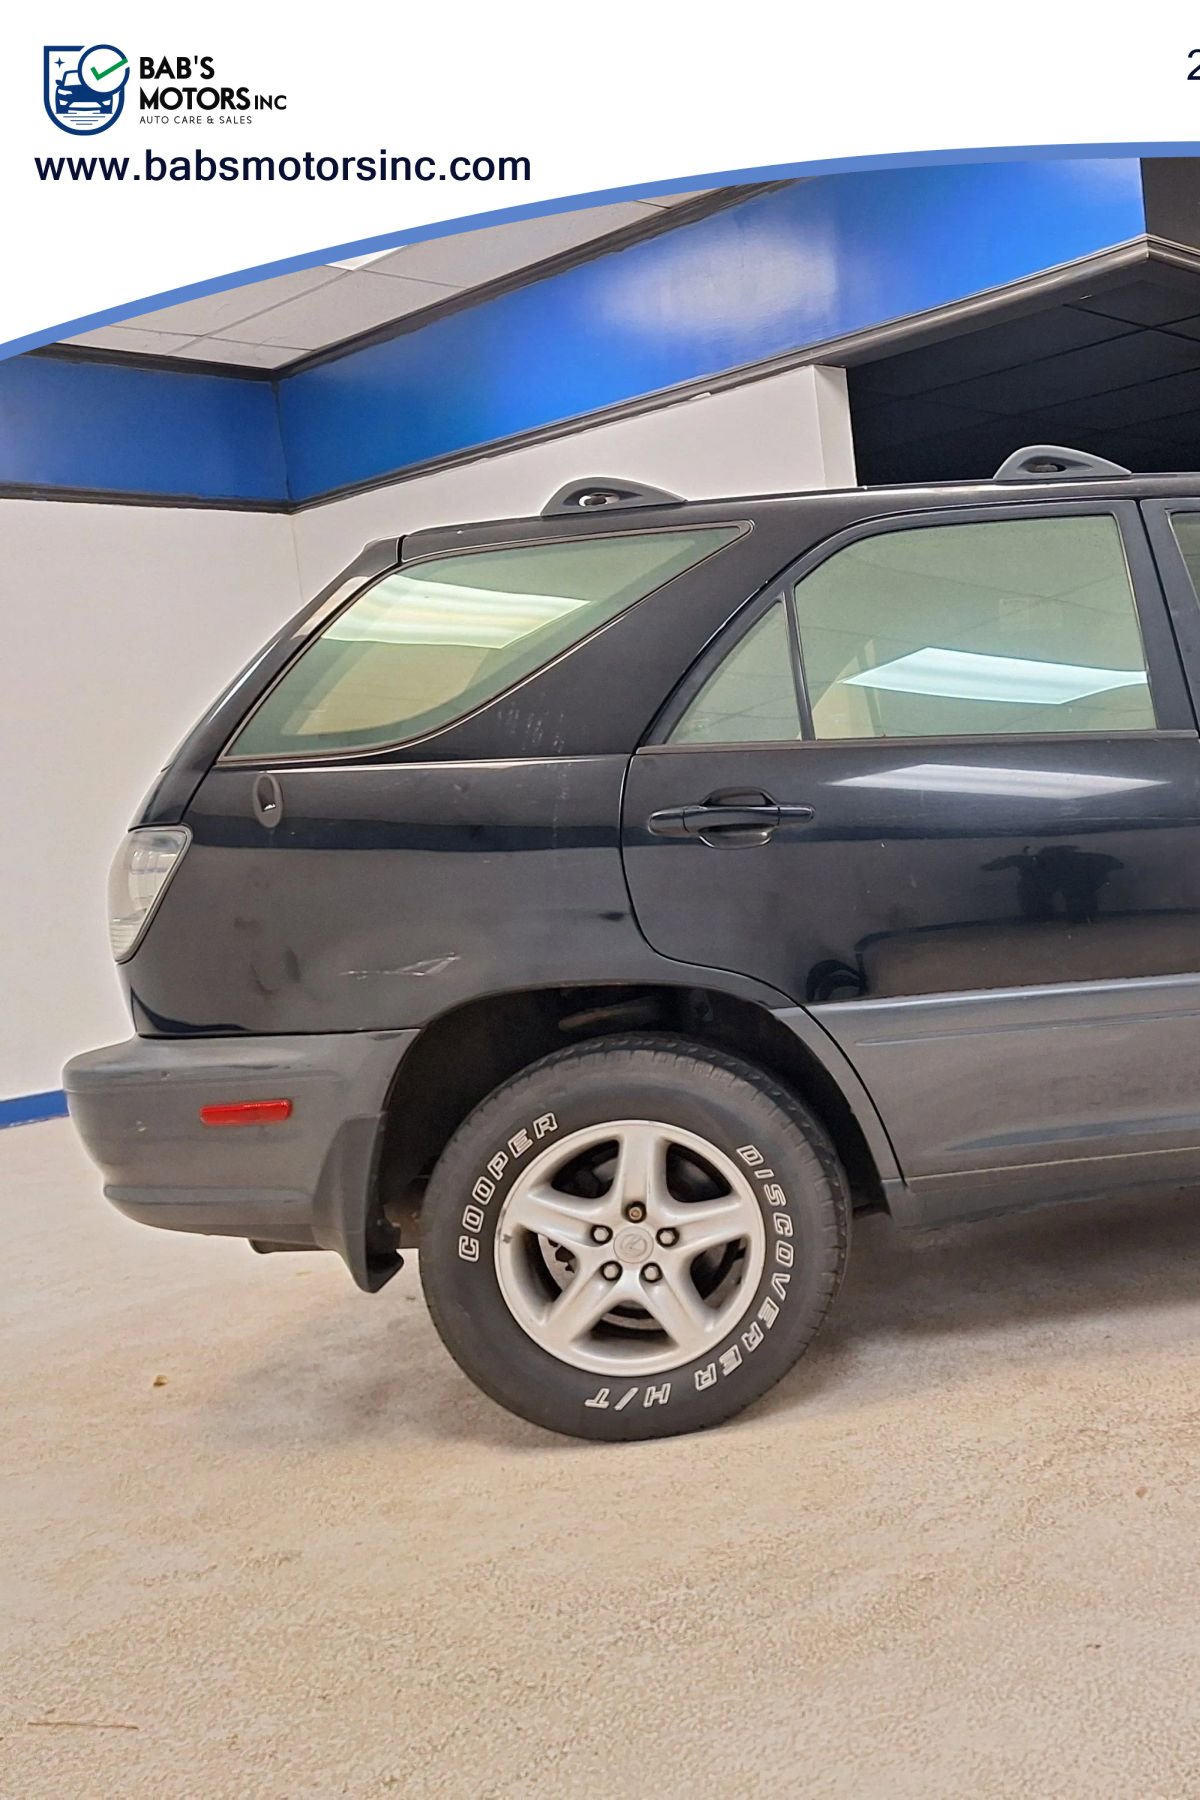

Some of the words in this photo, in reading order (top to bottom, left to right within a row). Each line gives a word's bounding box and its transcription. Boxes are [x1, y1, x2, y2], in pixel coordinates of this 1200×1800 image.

[458, 1112, 558, 1262] COOPER
[694, 1144, 795, 1391] DISCOVERER
[584, 1382, 672, 1411] H/T
